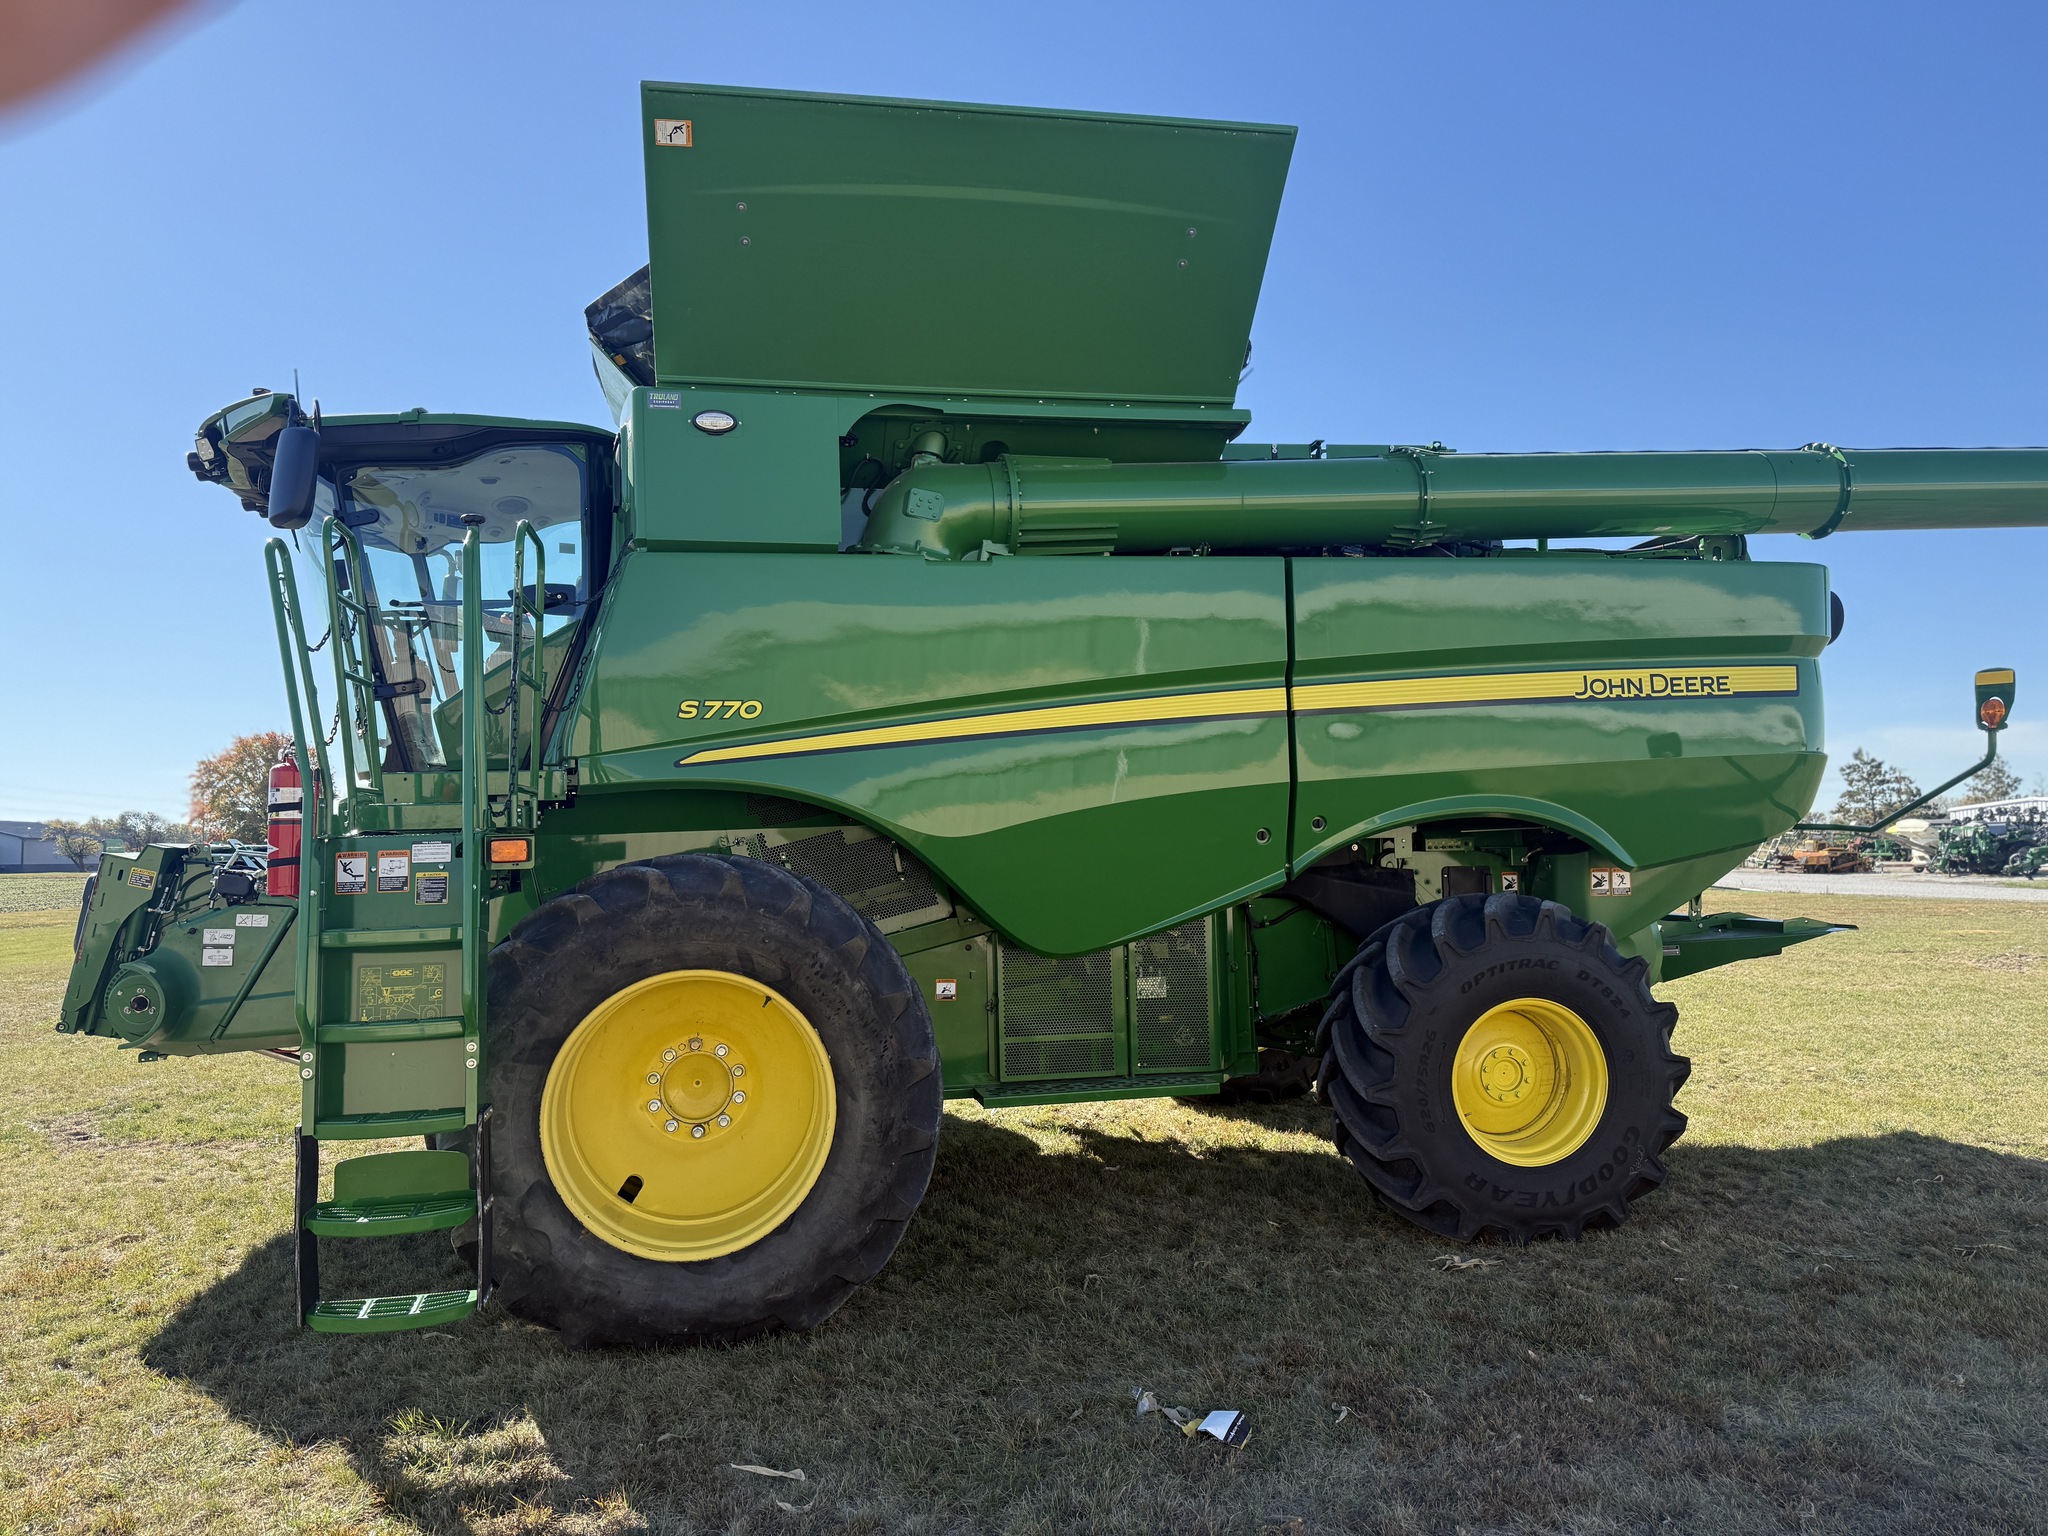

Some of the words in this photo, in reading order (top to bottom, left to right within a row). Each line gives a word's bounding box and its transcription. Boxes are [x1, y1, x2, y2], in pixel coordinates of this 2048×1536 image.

[1575, 675, 1644, 697] JOHN
[1650, 673, 1732, 695] DEERE
[677, 699, 763, 720] S770
[1460, 957, 1561, 995] OPTITRAC
[1576, 969, 1632, 1019] DT824
[1463, 1126, 1640, 1209] GOODYEAR
